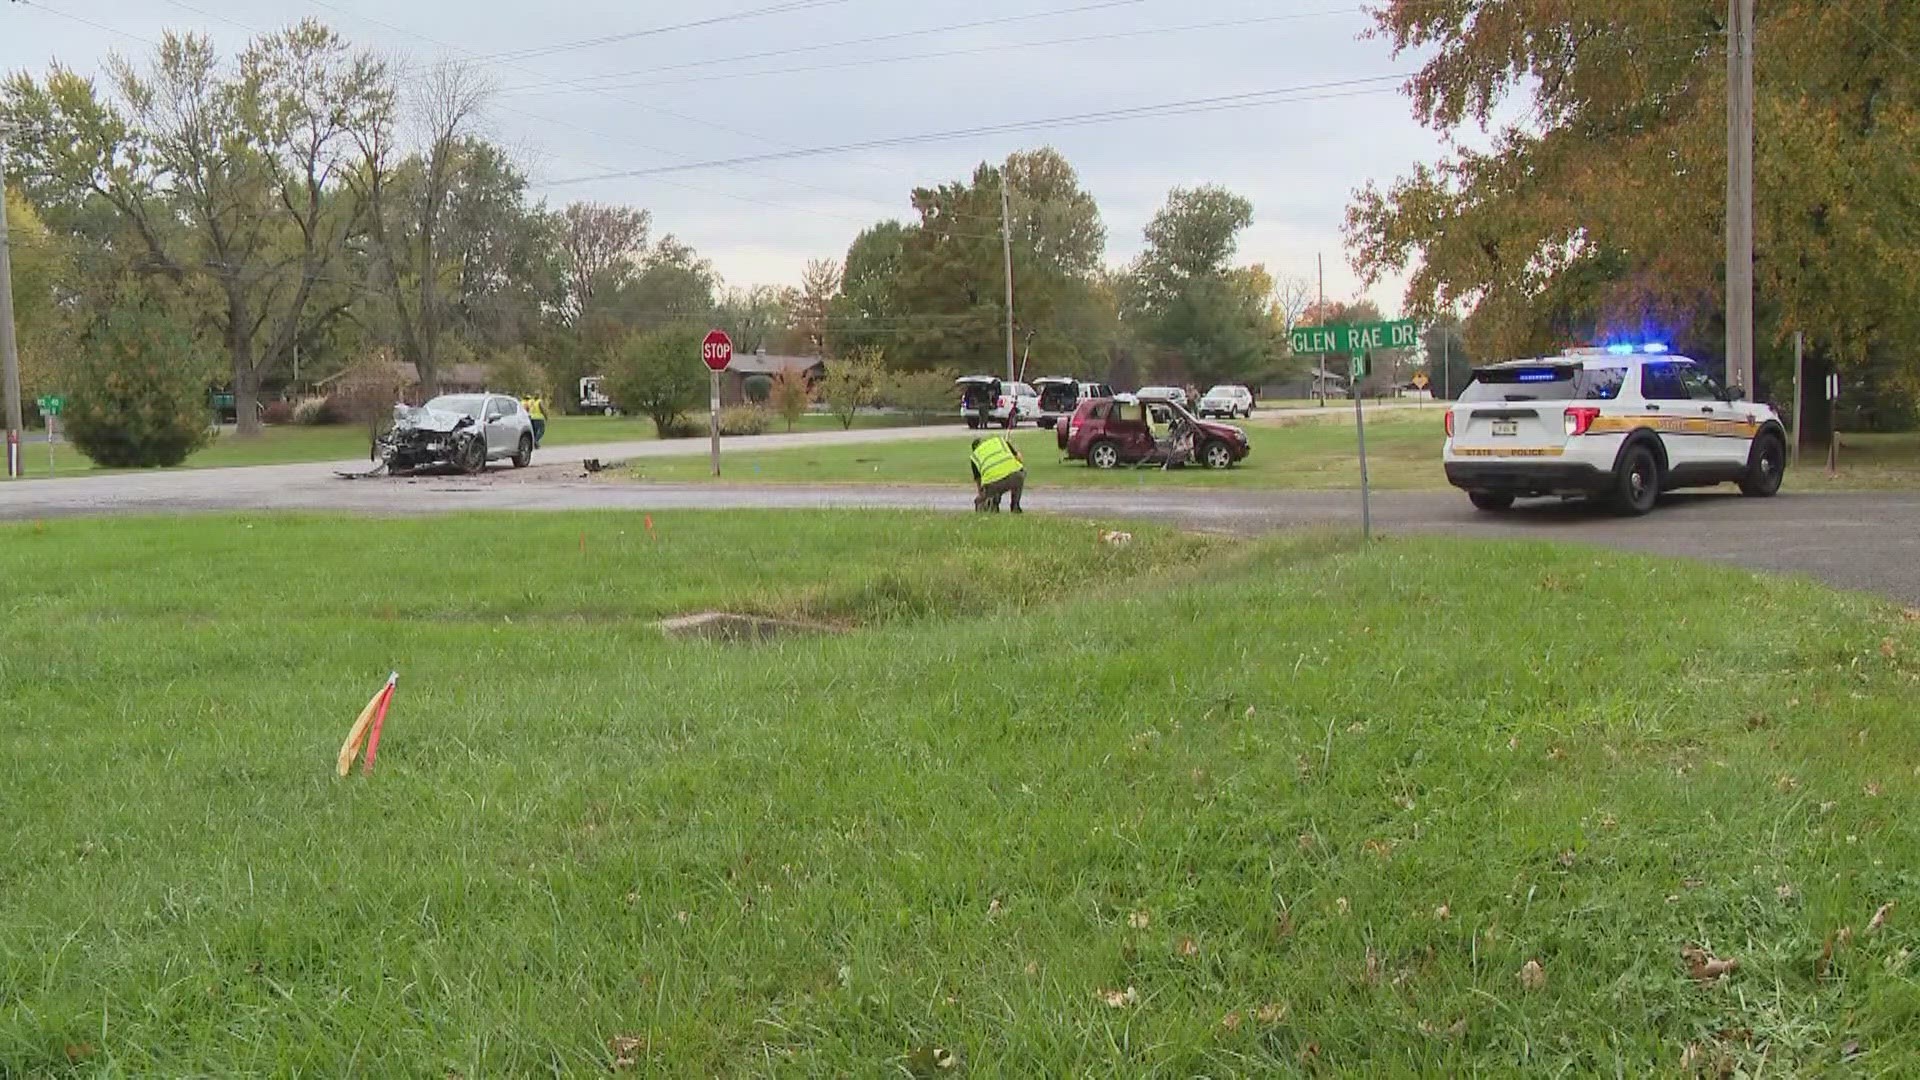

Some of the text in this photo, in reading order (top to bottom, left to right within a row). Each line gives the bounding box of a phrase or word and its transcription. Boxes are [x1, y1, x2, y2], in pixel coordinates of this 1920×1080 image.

[1292, 324, 1415, 353] GLEN RAE DR
[704, 342, 730, 359] STOP
[1510, 448, 1545, 456] POLICE
